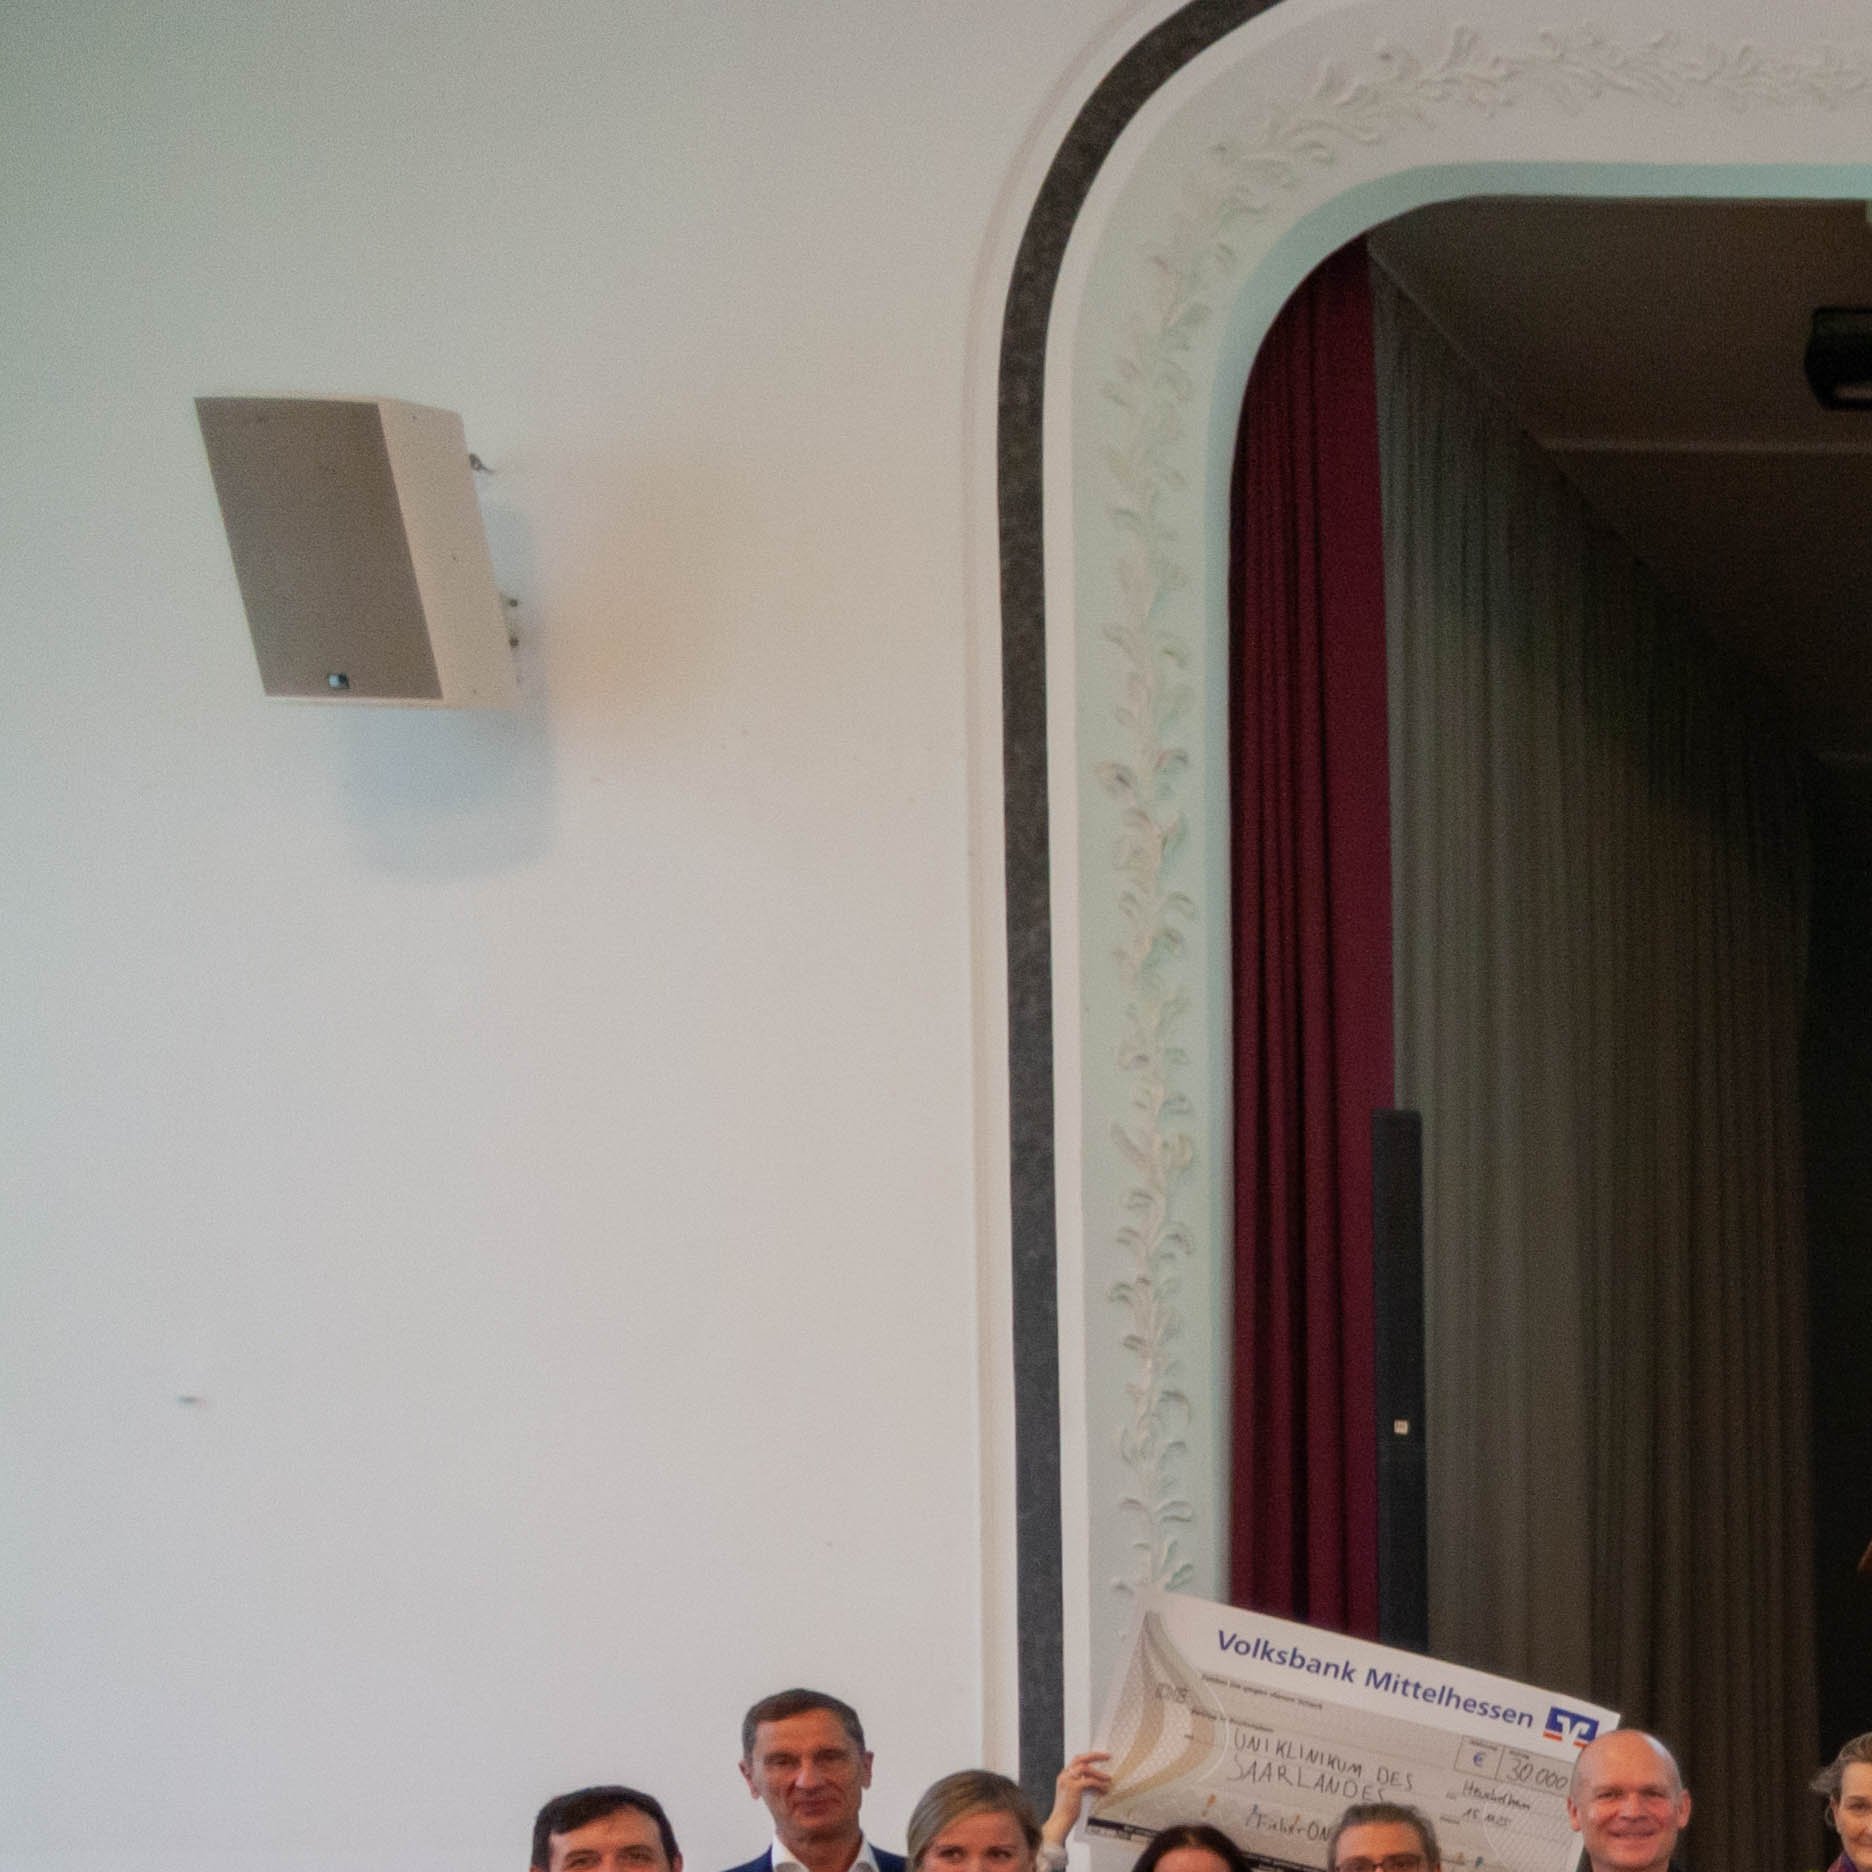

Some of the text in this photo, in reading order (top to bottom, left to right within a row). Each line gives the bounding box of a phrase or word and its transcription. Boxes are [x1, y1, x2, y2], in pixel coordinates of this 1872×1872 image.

[1217, 1630, 1534, 1729] Volksbank Mittelhessen
[1471, 1751, 1486, 1769] €
[1376, 1765, 1415, 1792] DES
